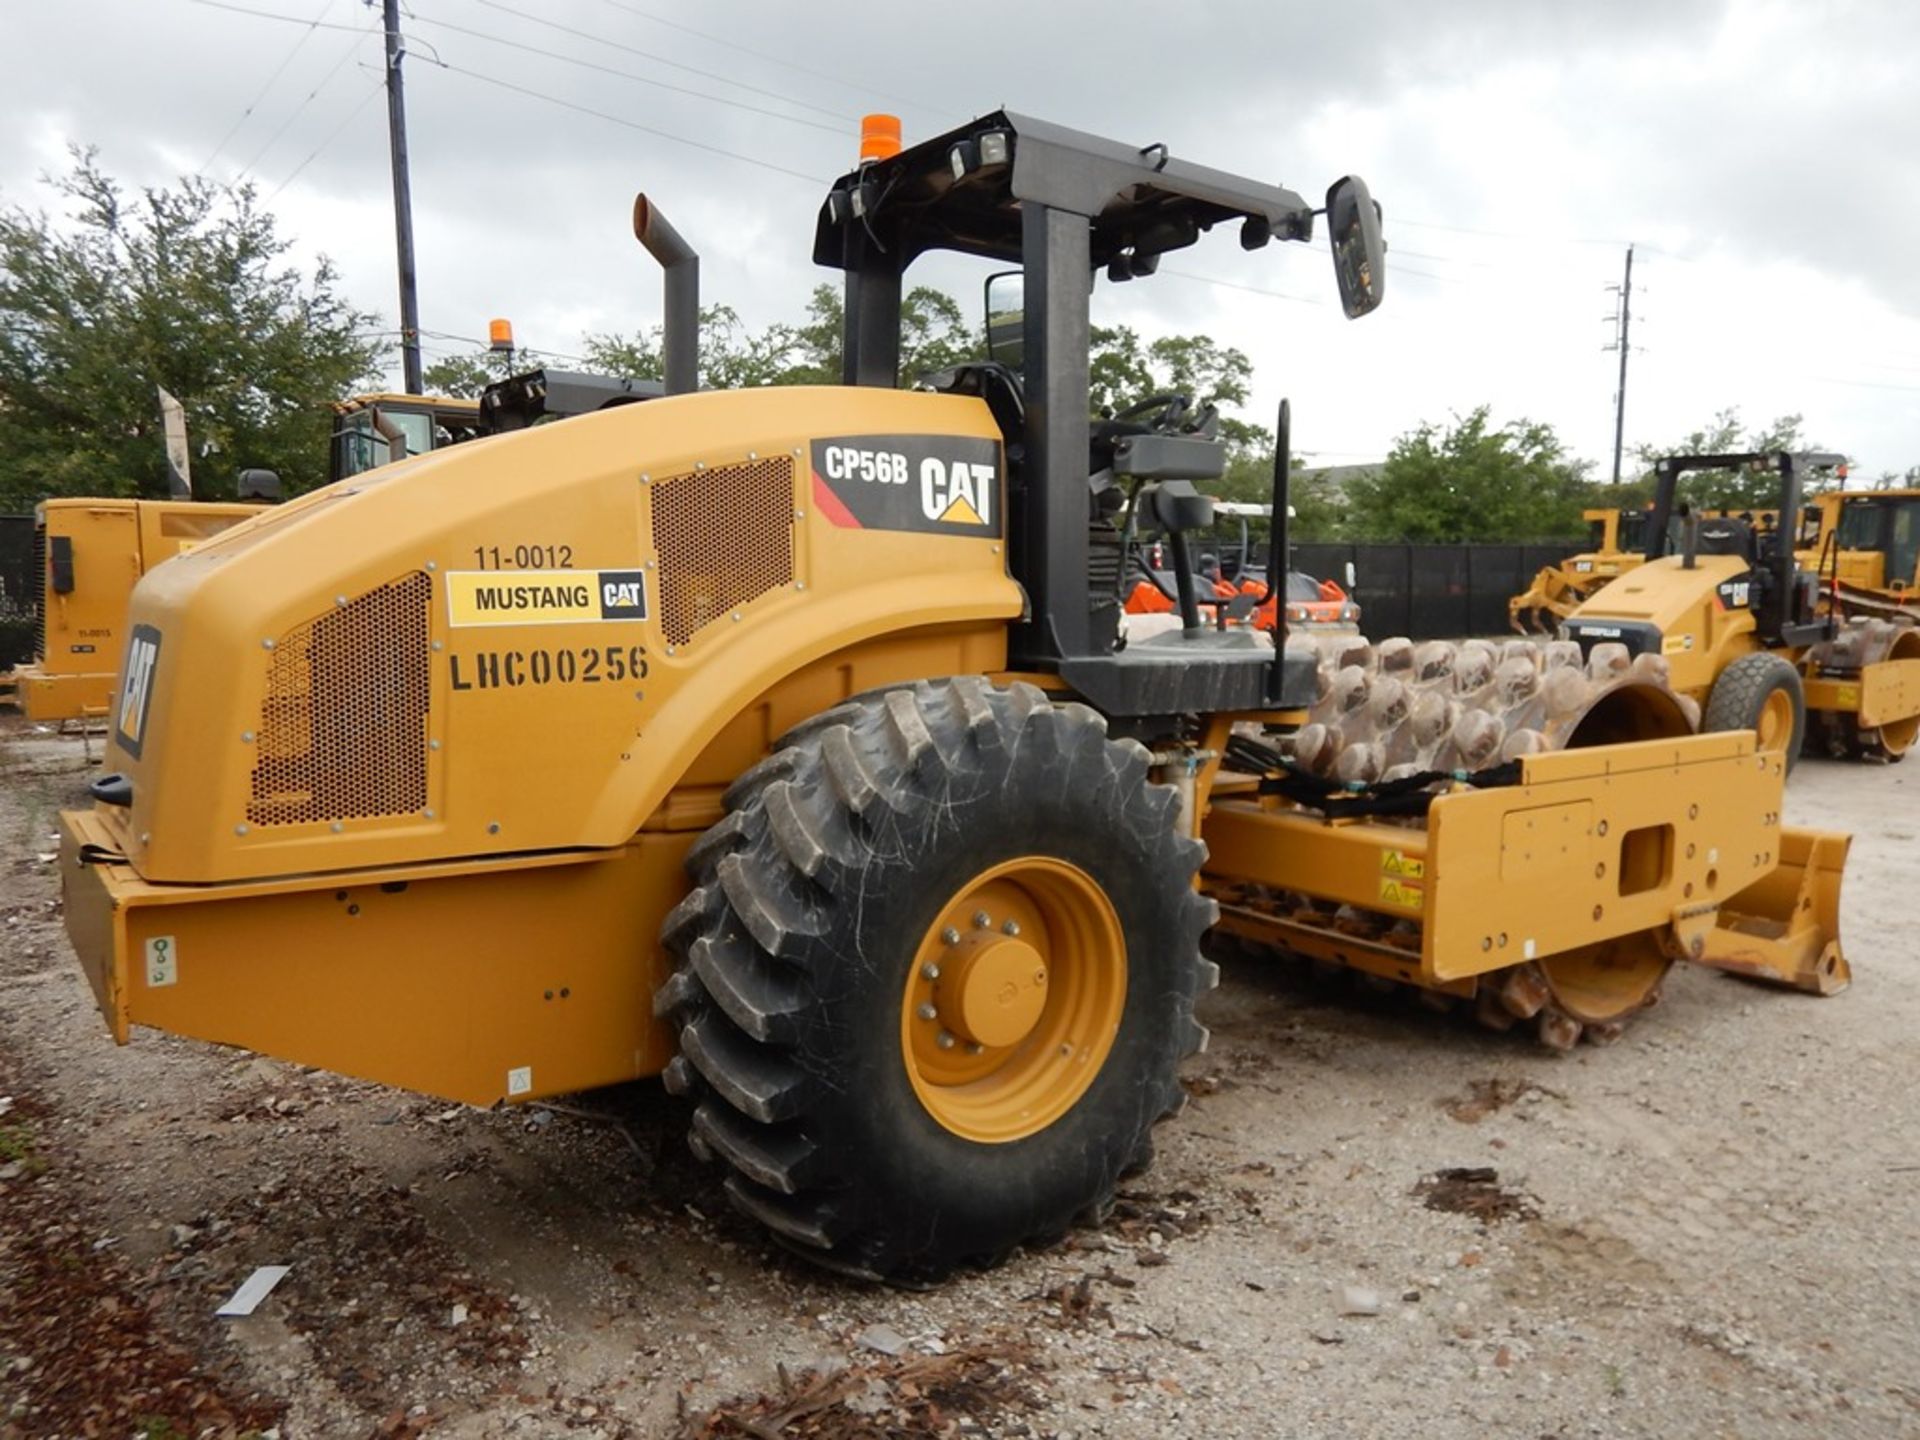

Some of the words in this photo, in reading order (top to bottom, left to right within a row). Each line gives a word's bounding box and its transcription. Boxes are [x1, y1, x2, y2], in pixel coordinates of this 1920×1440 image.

[825, 446, 908, 484] CP56B
[920, 457, 995, 526] CAT
[473, 544, 573, 570] 11-0012
[475, 586, 590, 610] MUSTANG
[602, 583, 641, 607] CAT
[450, 646, 649, 691] LHC00256
[119, 637, 157, 743] CAT
